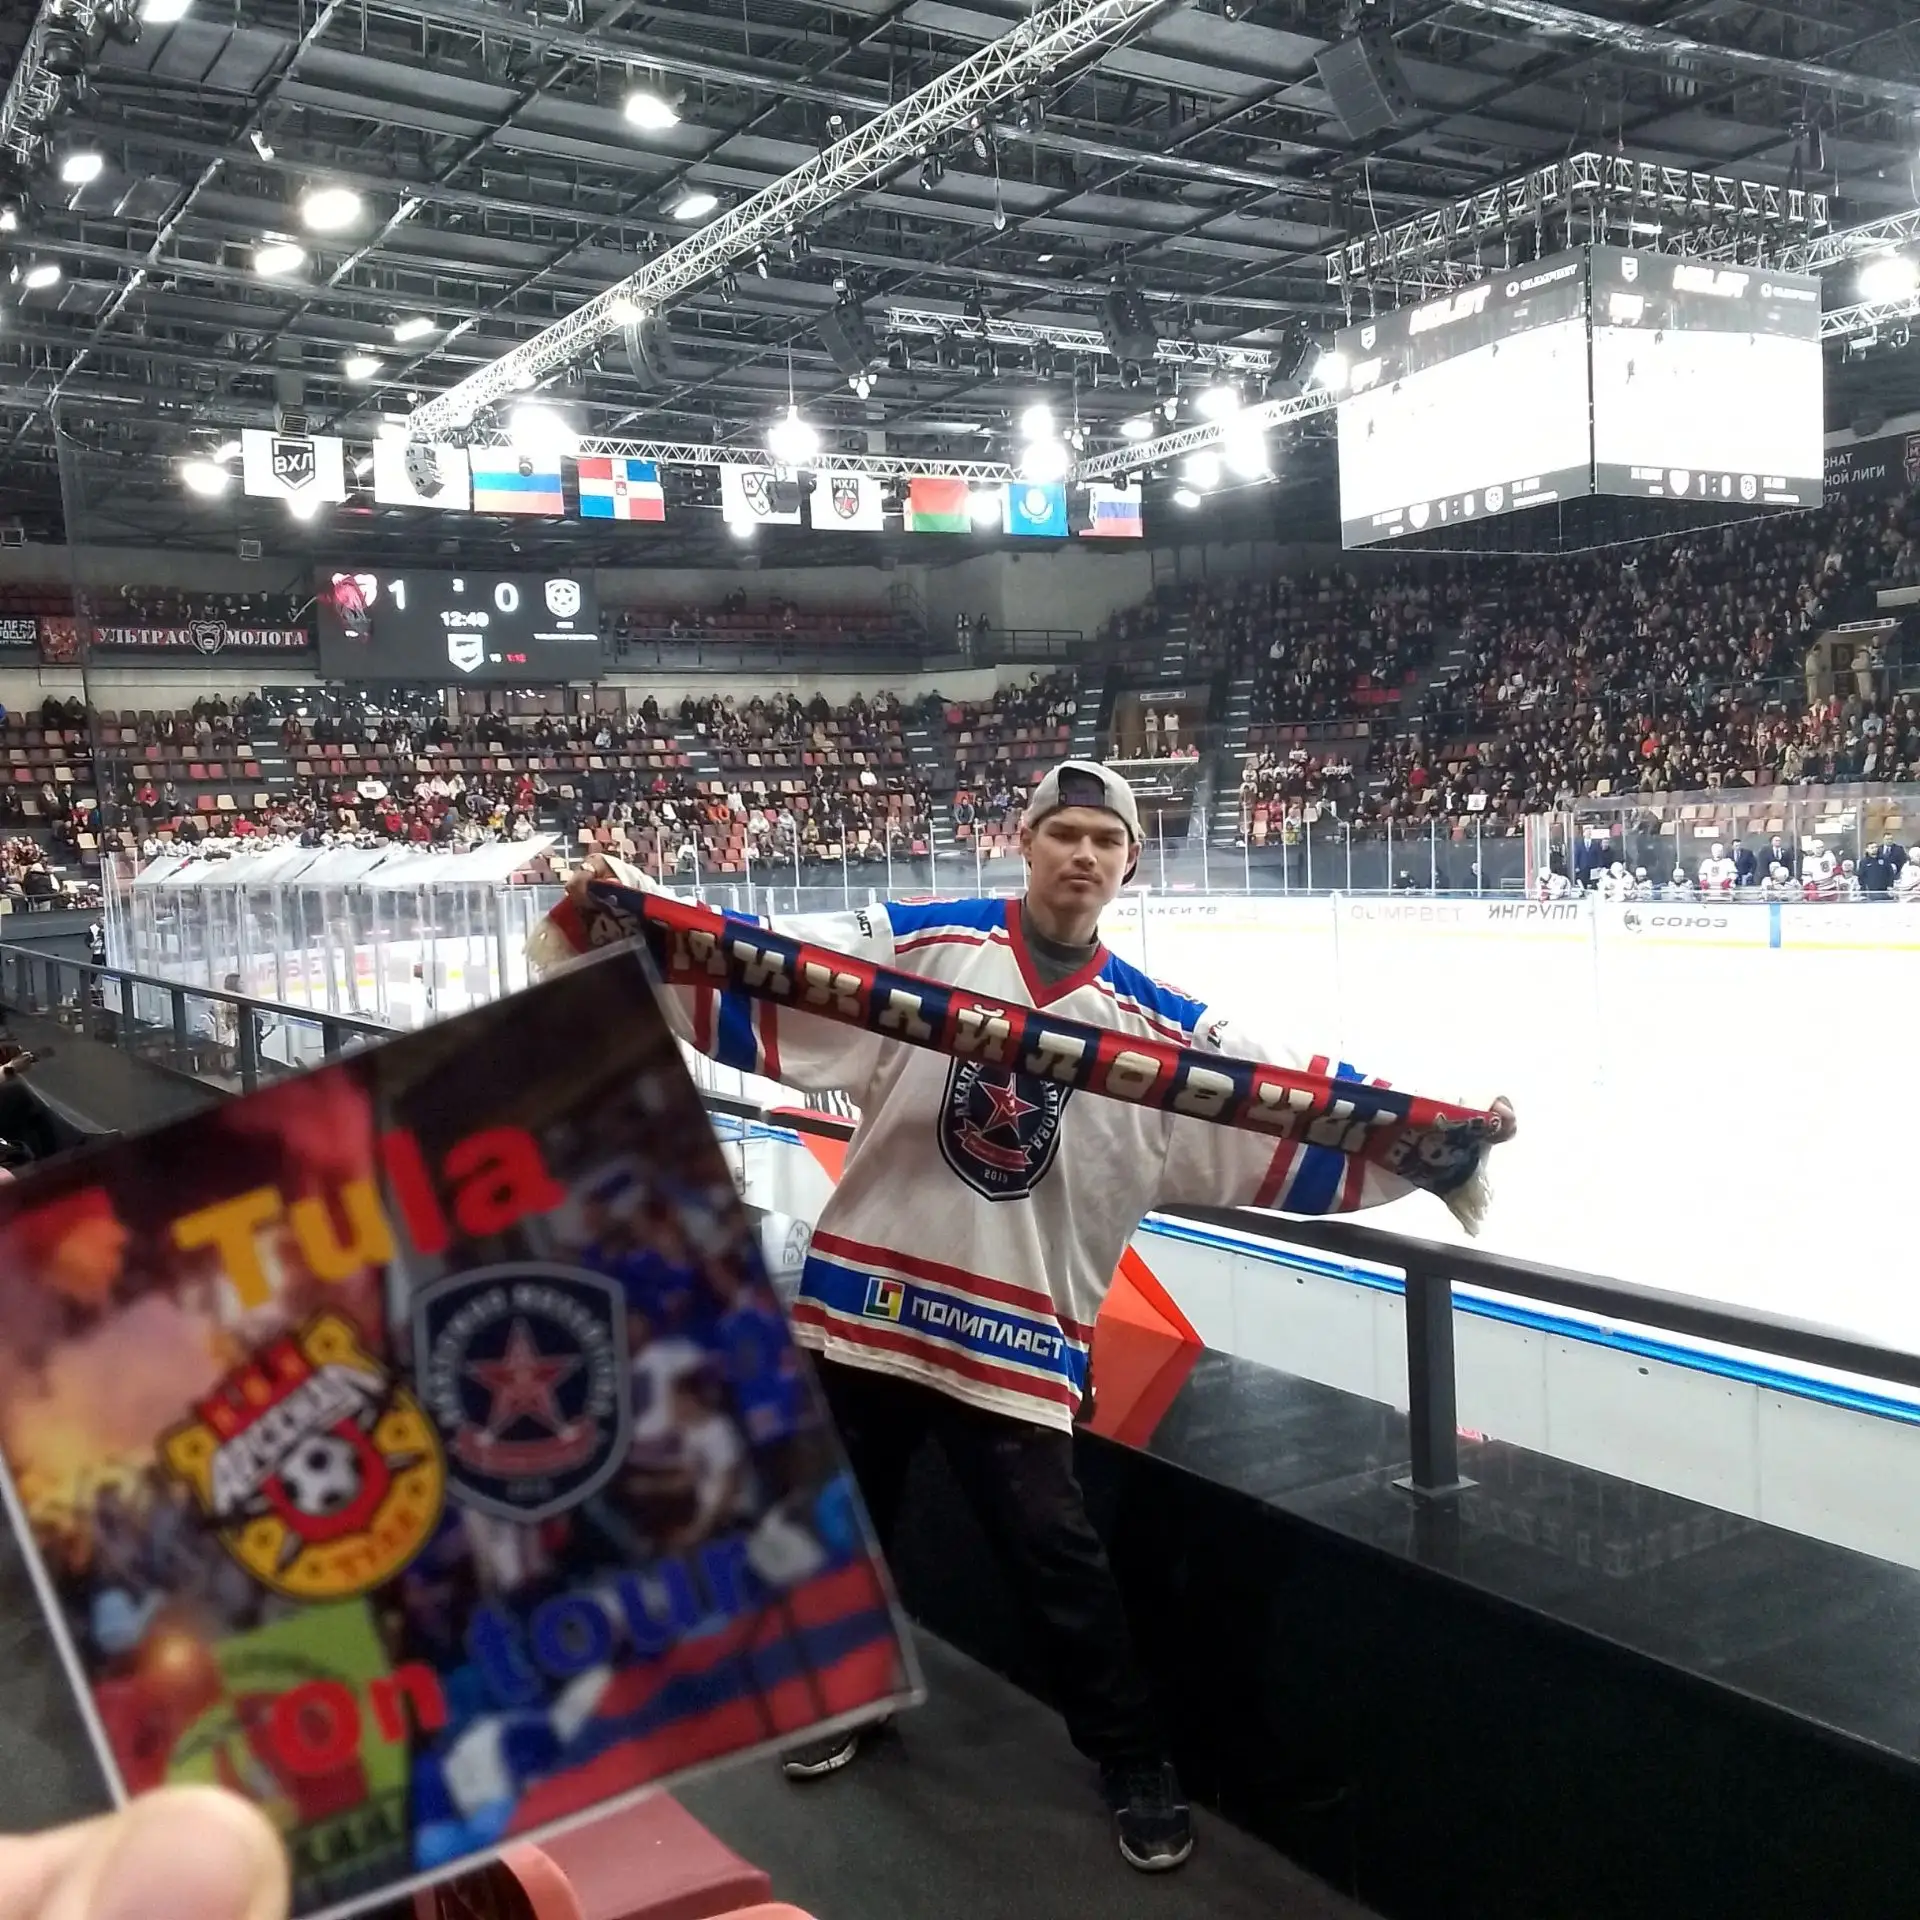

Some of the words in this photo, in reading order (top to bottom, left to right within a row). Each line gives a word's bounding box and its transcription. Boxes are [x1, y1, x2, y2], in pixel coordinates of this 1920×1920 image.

[274, 453, 314, 474] ВХЛ
[1851, 465, 1886, 482] ЛИГИ
[832, 478, 857, 489] МХЛ
[388, 579, 406, 611] 1
[494, 582, 519, 612] 0
[97, 627, 191, 646] УЛЬТРАС
[226, 629, 305, 646] МОЛОТА
[1488, 904, 1578, 920] ИНГРУПП
[1651, 916, 1728, 928] СОЮЗ
[171, 1125, 566, 1310] Tula
[911, 1295, 1064, 1360] ПОЛИПЛАСТ
[467, 1535, 748, 1698] tour
[269, 1661, 446, 1775] on
